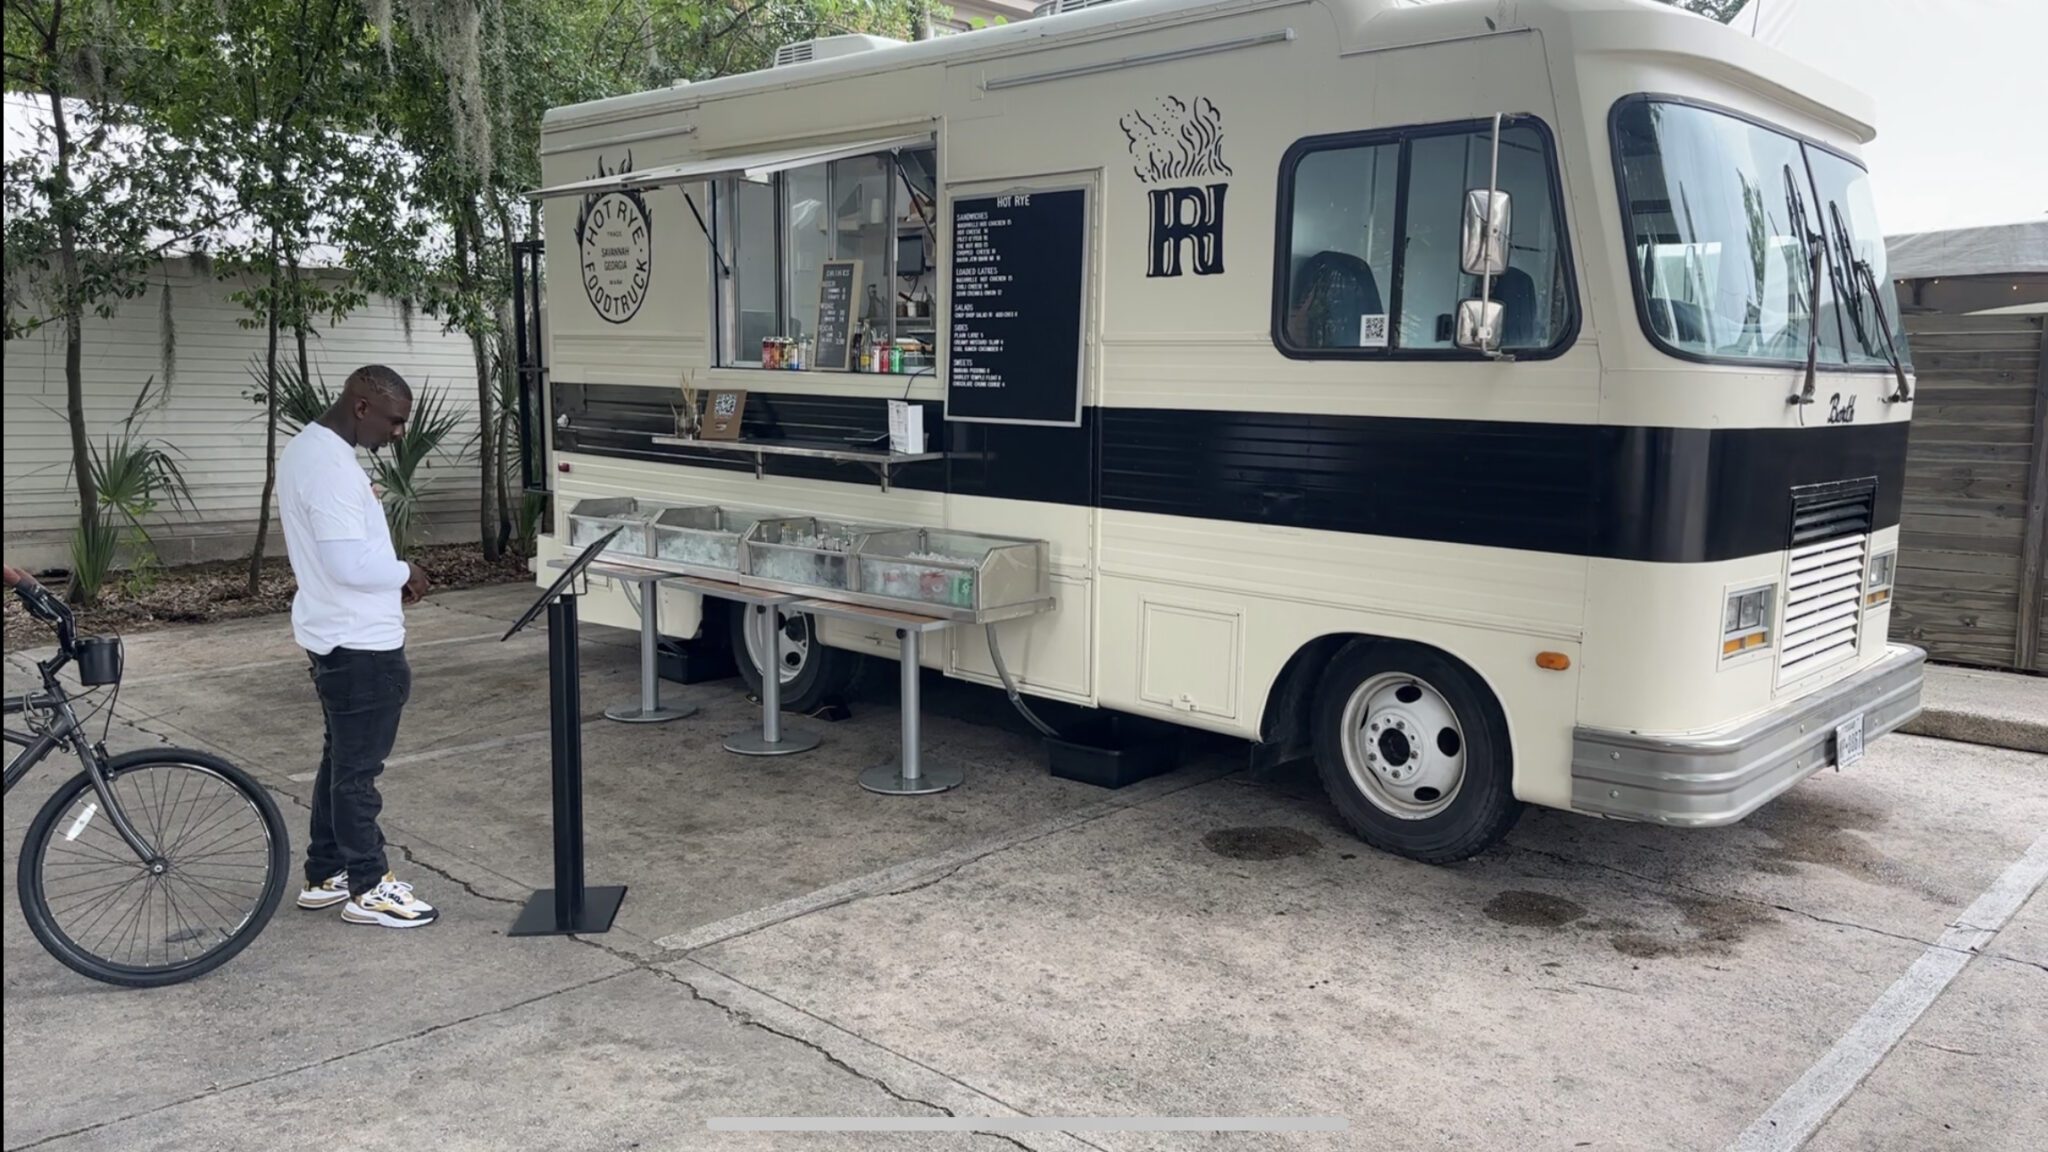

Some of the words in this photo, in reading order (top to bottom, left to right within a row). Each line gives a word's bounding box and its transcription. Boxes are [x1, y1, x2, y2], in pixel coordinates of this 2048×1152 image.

[997, 196, 1011, 208] HOT
[1014, 195, 1030, 207] RYE
[586, 200, 611, 247] HOT
[617, 200, 644, 245] RYE
[601, 247, 630, 258] SAVANNAH
[604, 260, 627, 271] GEORGIA
[956, 267, 976, 276] LOADED
[585, 258, 648, 315] FOODTRUCK
